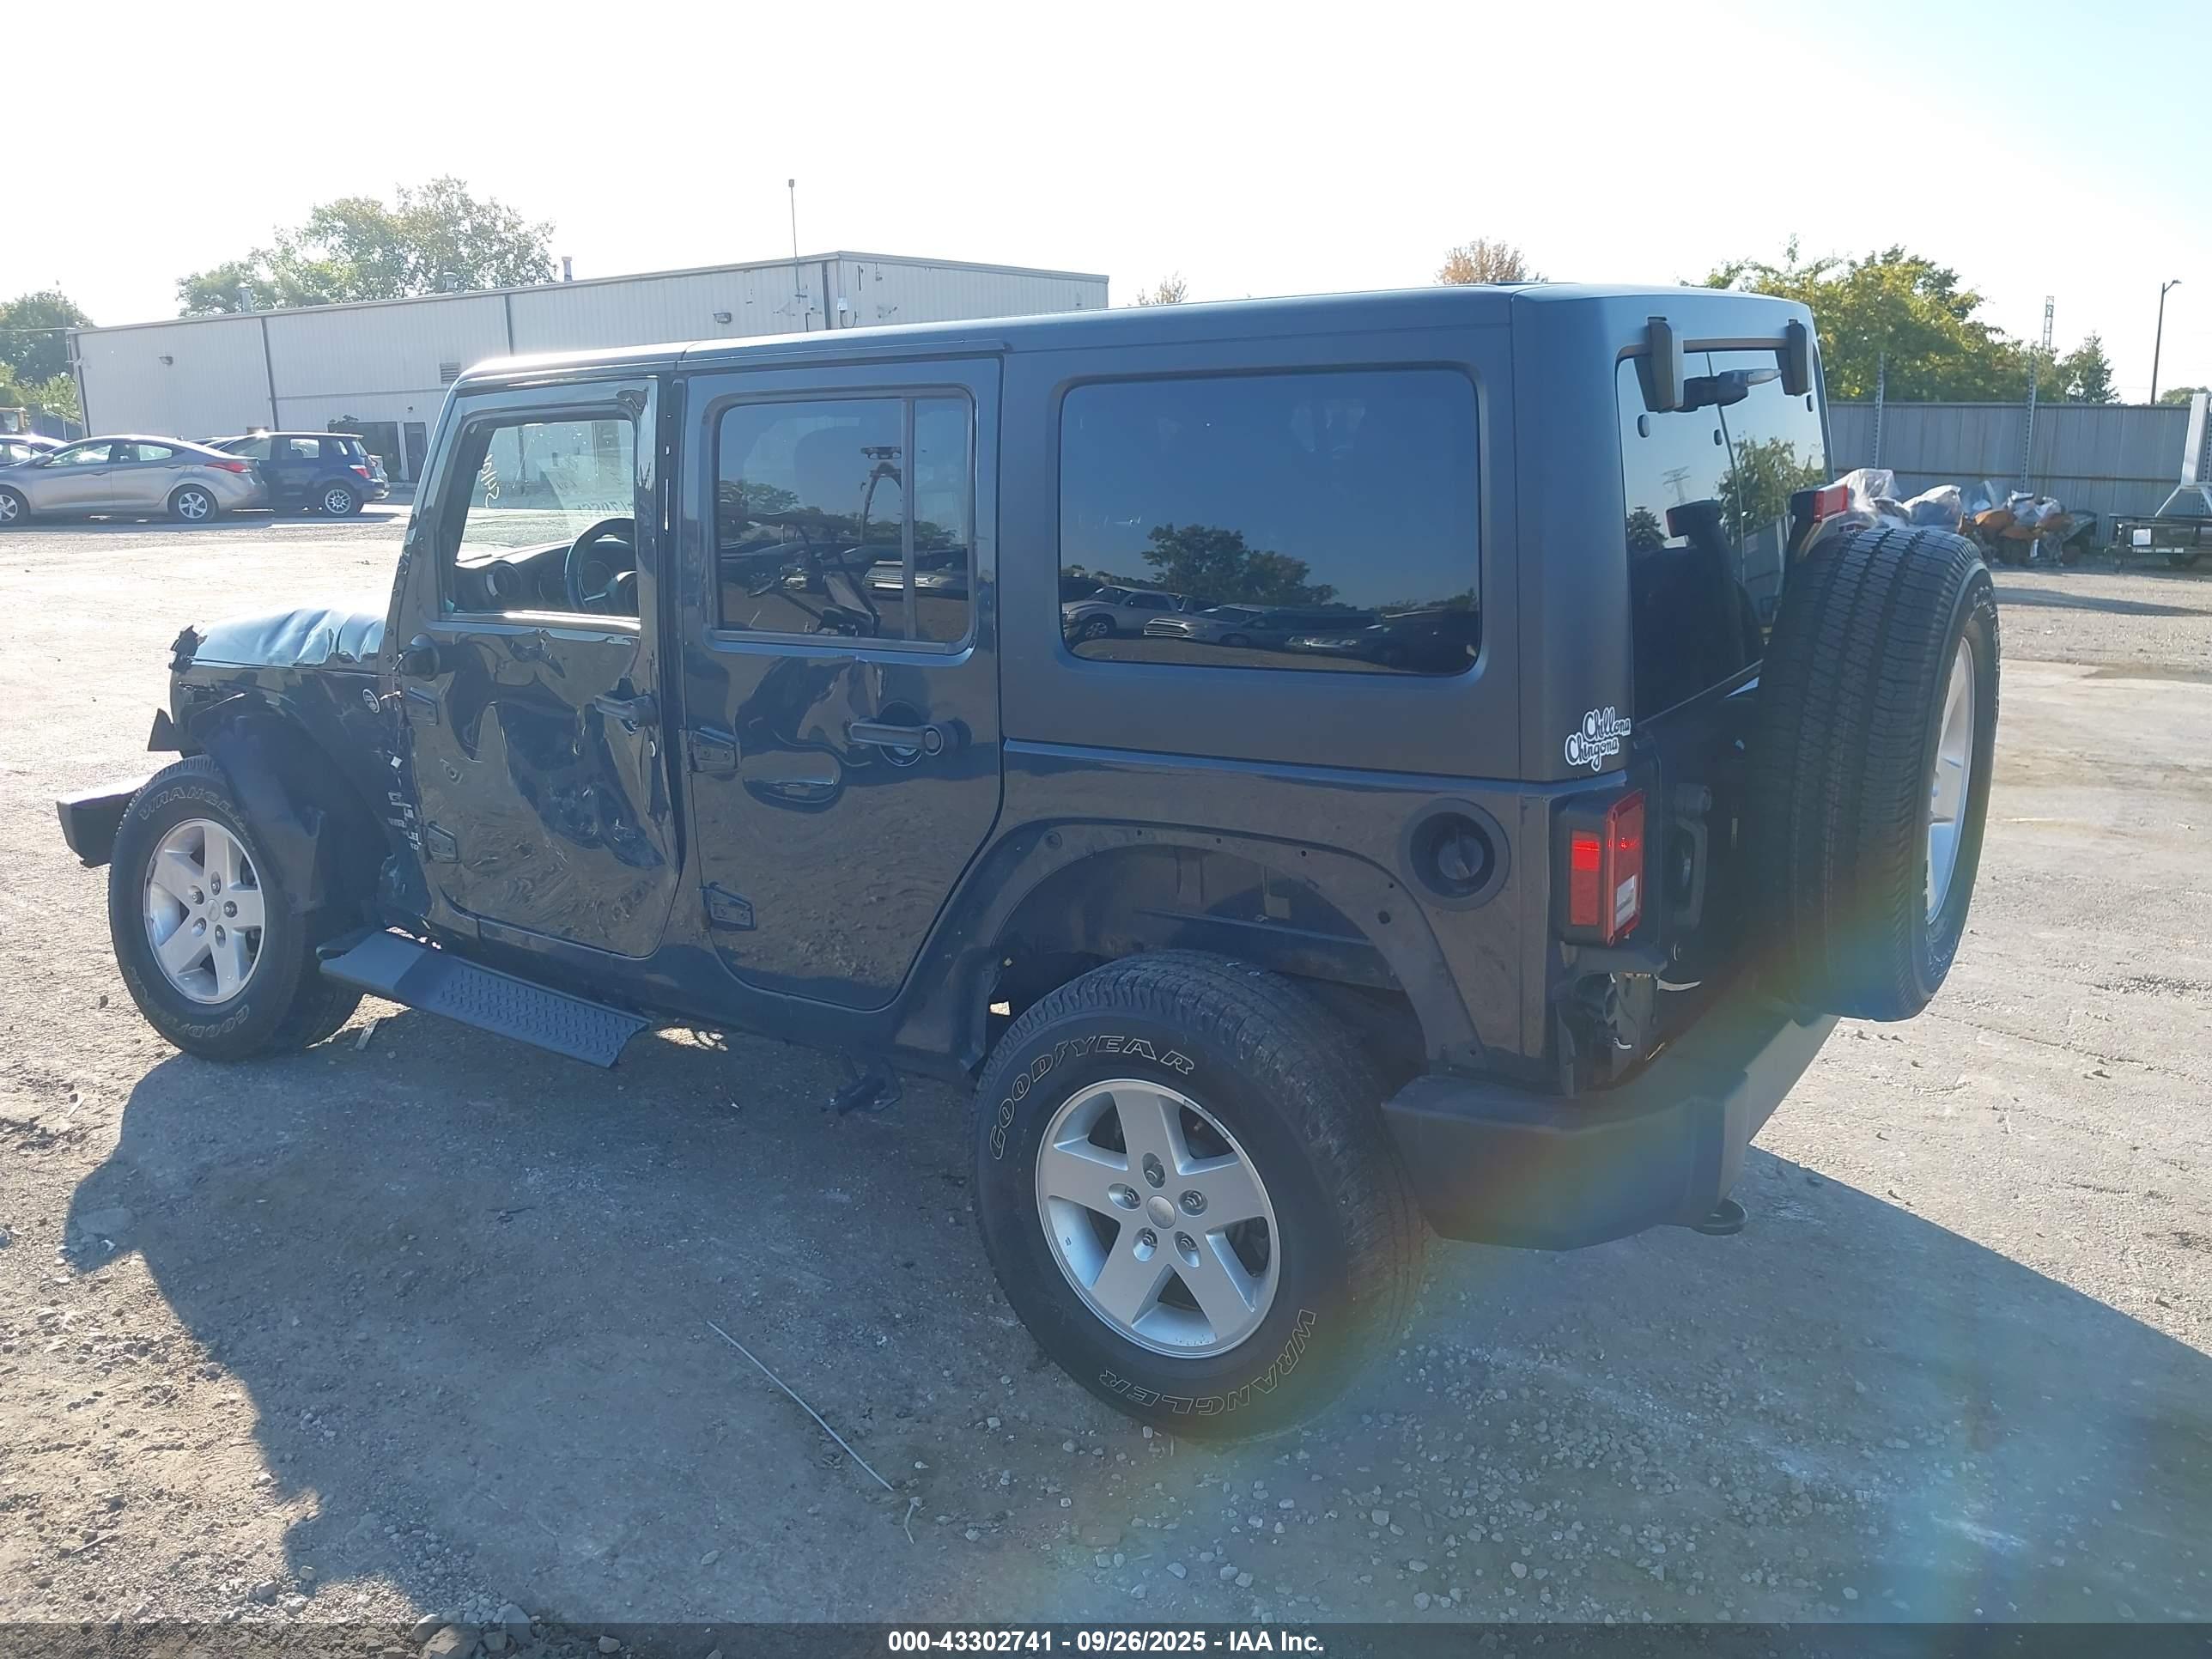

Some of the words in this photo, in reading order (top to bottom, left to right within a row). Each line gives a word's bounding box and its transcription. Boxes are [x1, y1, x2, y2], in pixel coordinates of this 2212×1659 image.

[1582, 706, 1632, 742] Chillona
[1565, 732, 1620, 772] Chingona
[137, 786, 254, 848] WRANGLE
[1098, 1309, 1317, 1416] WRANGLER
